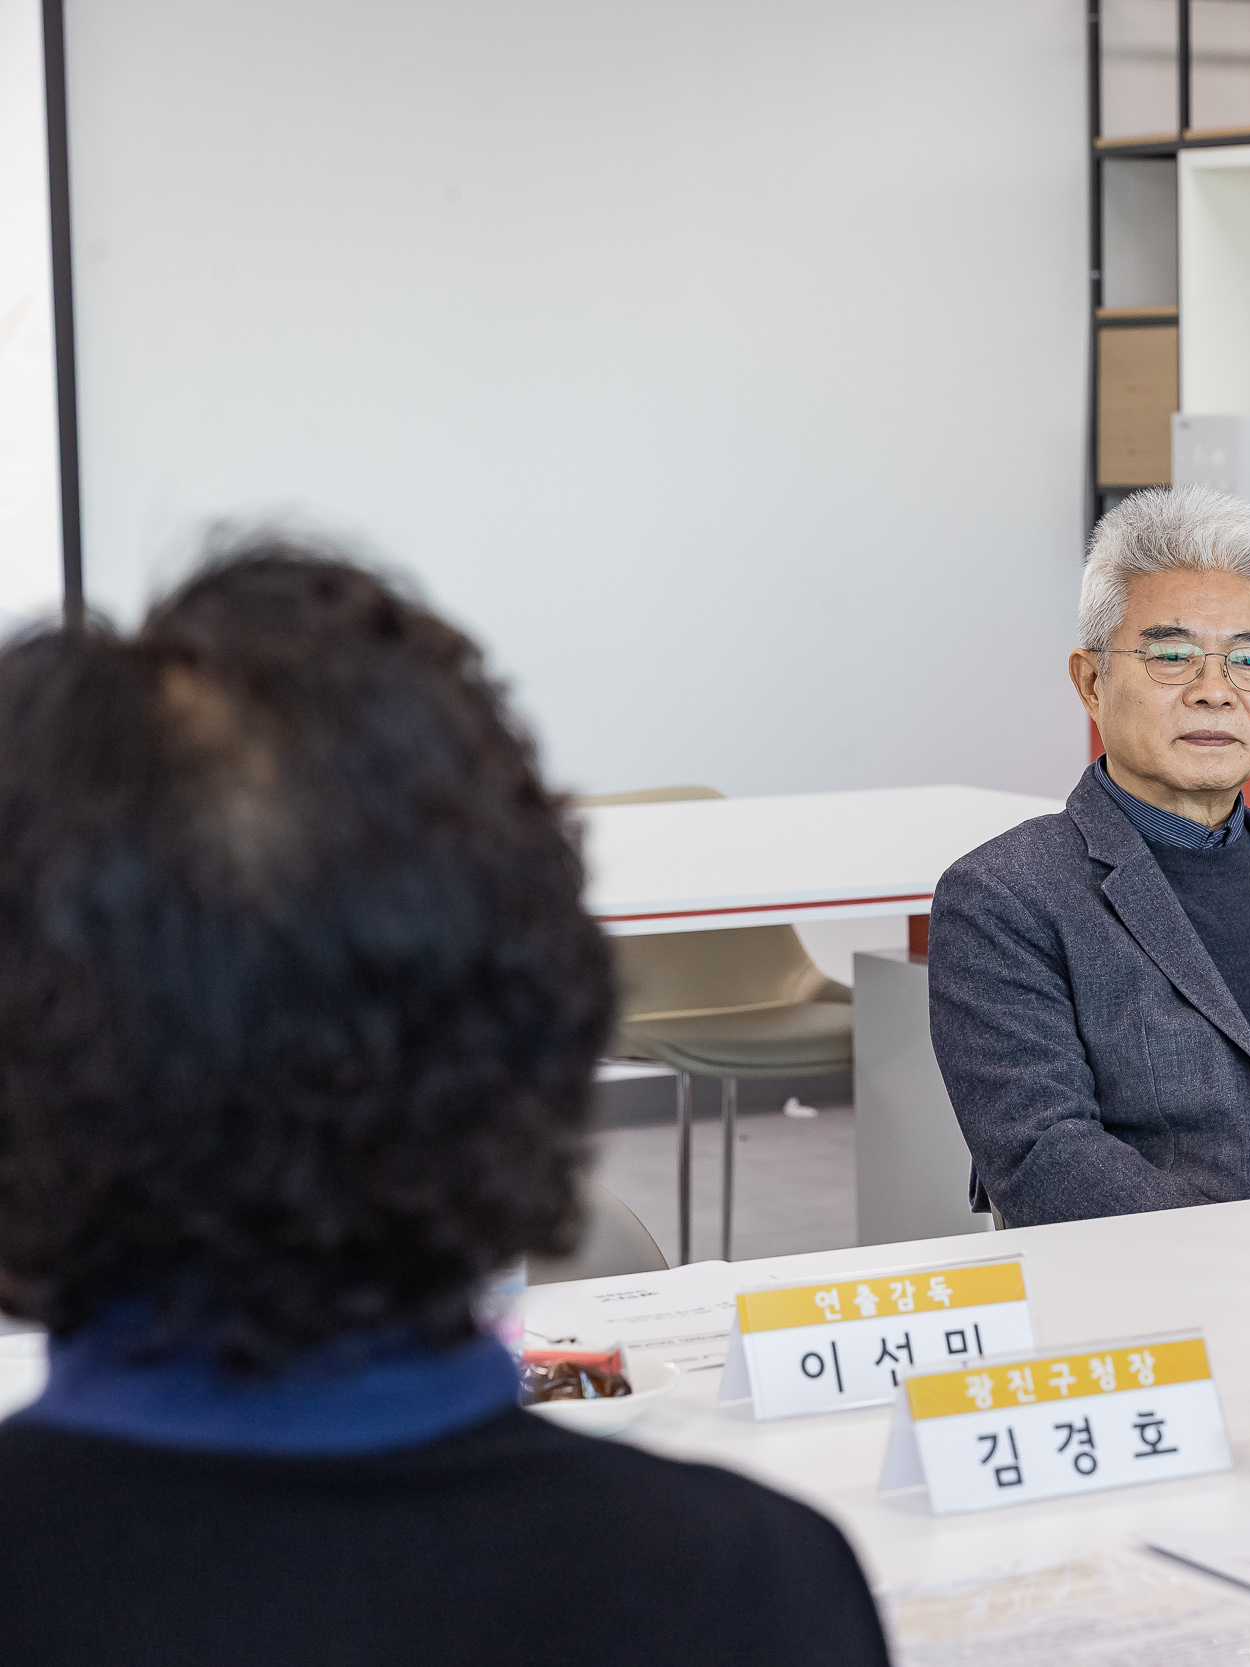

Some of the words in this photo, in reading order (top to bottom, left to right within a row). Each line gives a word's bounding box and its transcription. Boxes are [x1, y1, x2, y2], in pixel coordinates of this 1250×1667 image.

[815, 1276, 954, 1321] 연출감독
[965, 1351, 1156, 1409] 광진구청장
[977, 1411, 1178, 1489] 김경호
